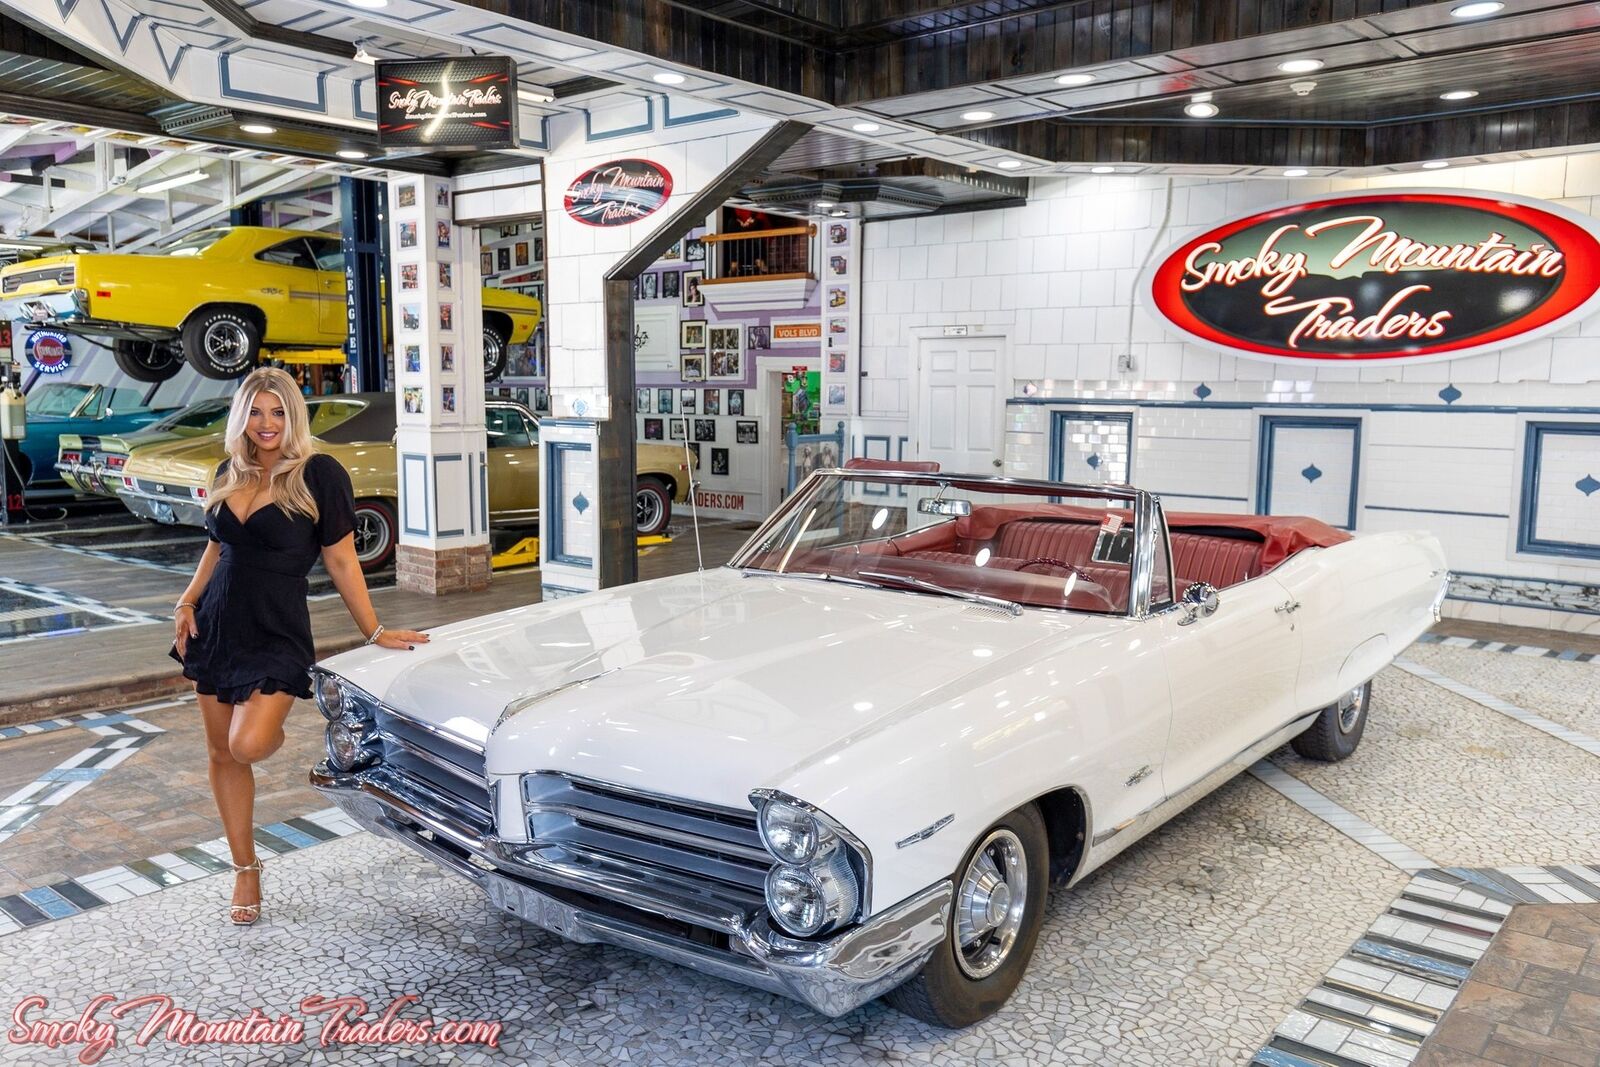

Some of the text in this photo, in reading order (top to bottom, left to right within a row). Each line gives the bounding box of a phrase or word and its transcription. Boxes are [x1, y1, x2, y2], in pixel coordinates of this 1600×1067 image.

[463, 85, 502, 108] Traders
[572, 166, 665, 203] Smoky Mountain
[595, 193, 639, 225] Traders
[1179, 214, 1567, 298] Smoky Mountain
[346, 279, 357, 349] EAGLE
[1263, 283, 1453, 351] Traders
[778, 328, 818, 337] VOLS BLVD
[34, 360, 69, 373] SERVICE
